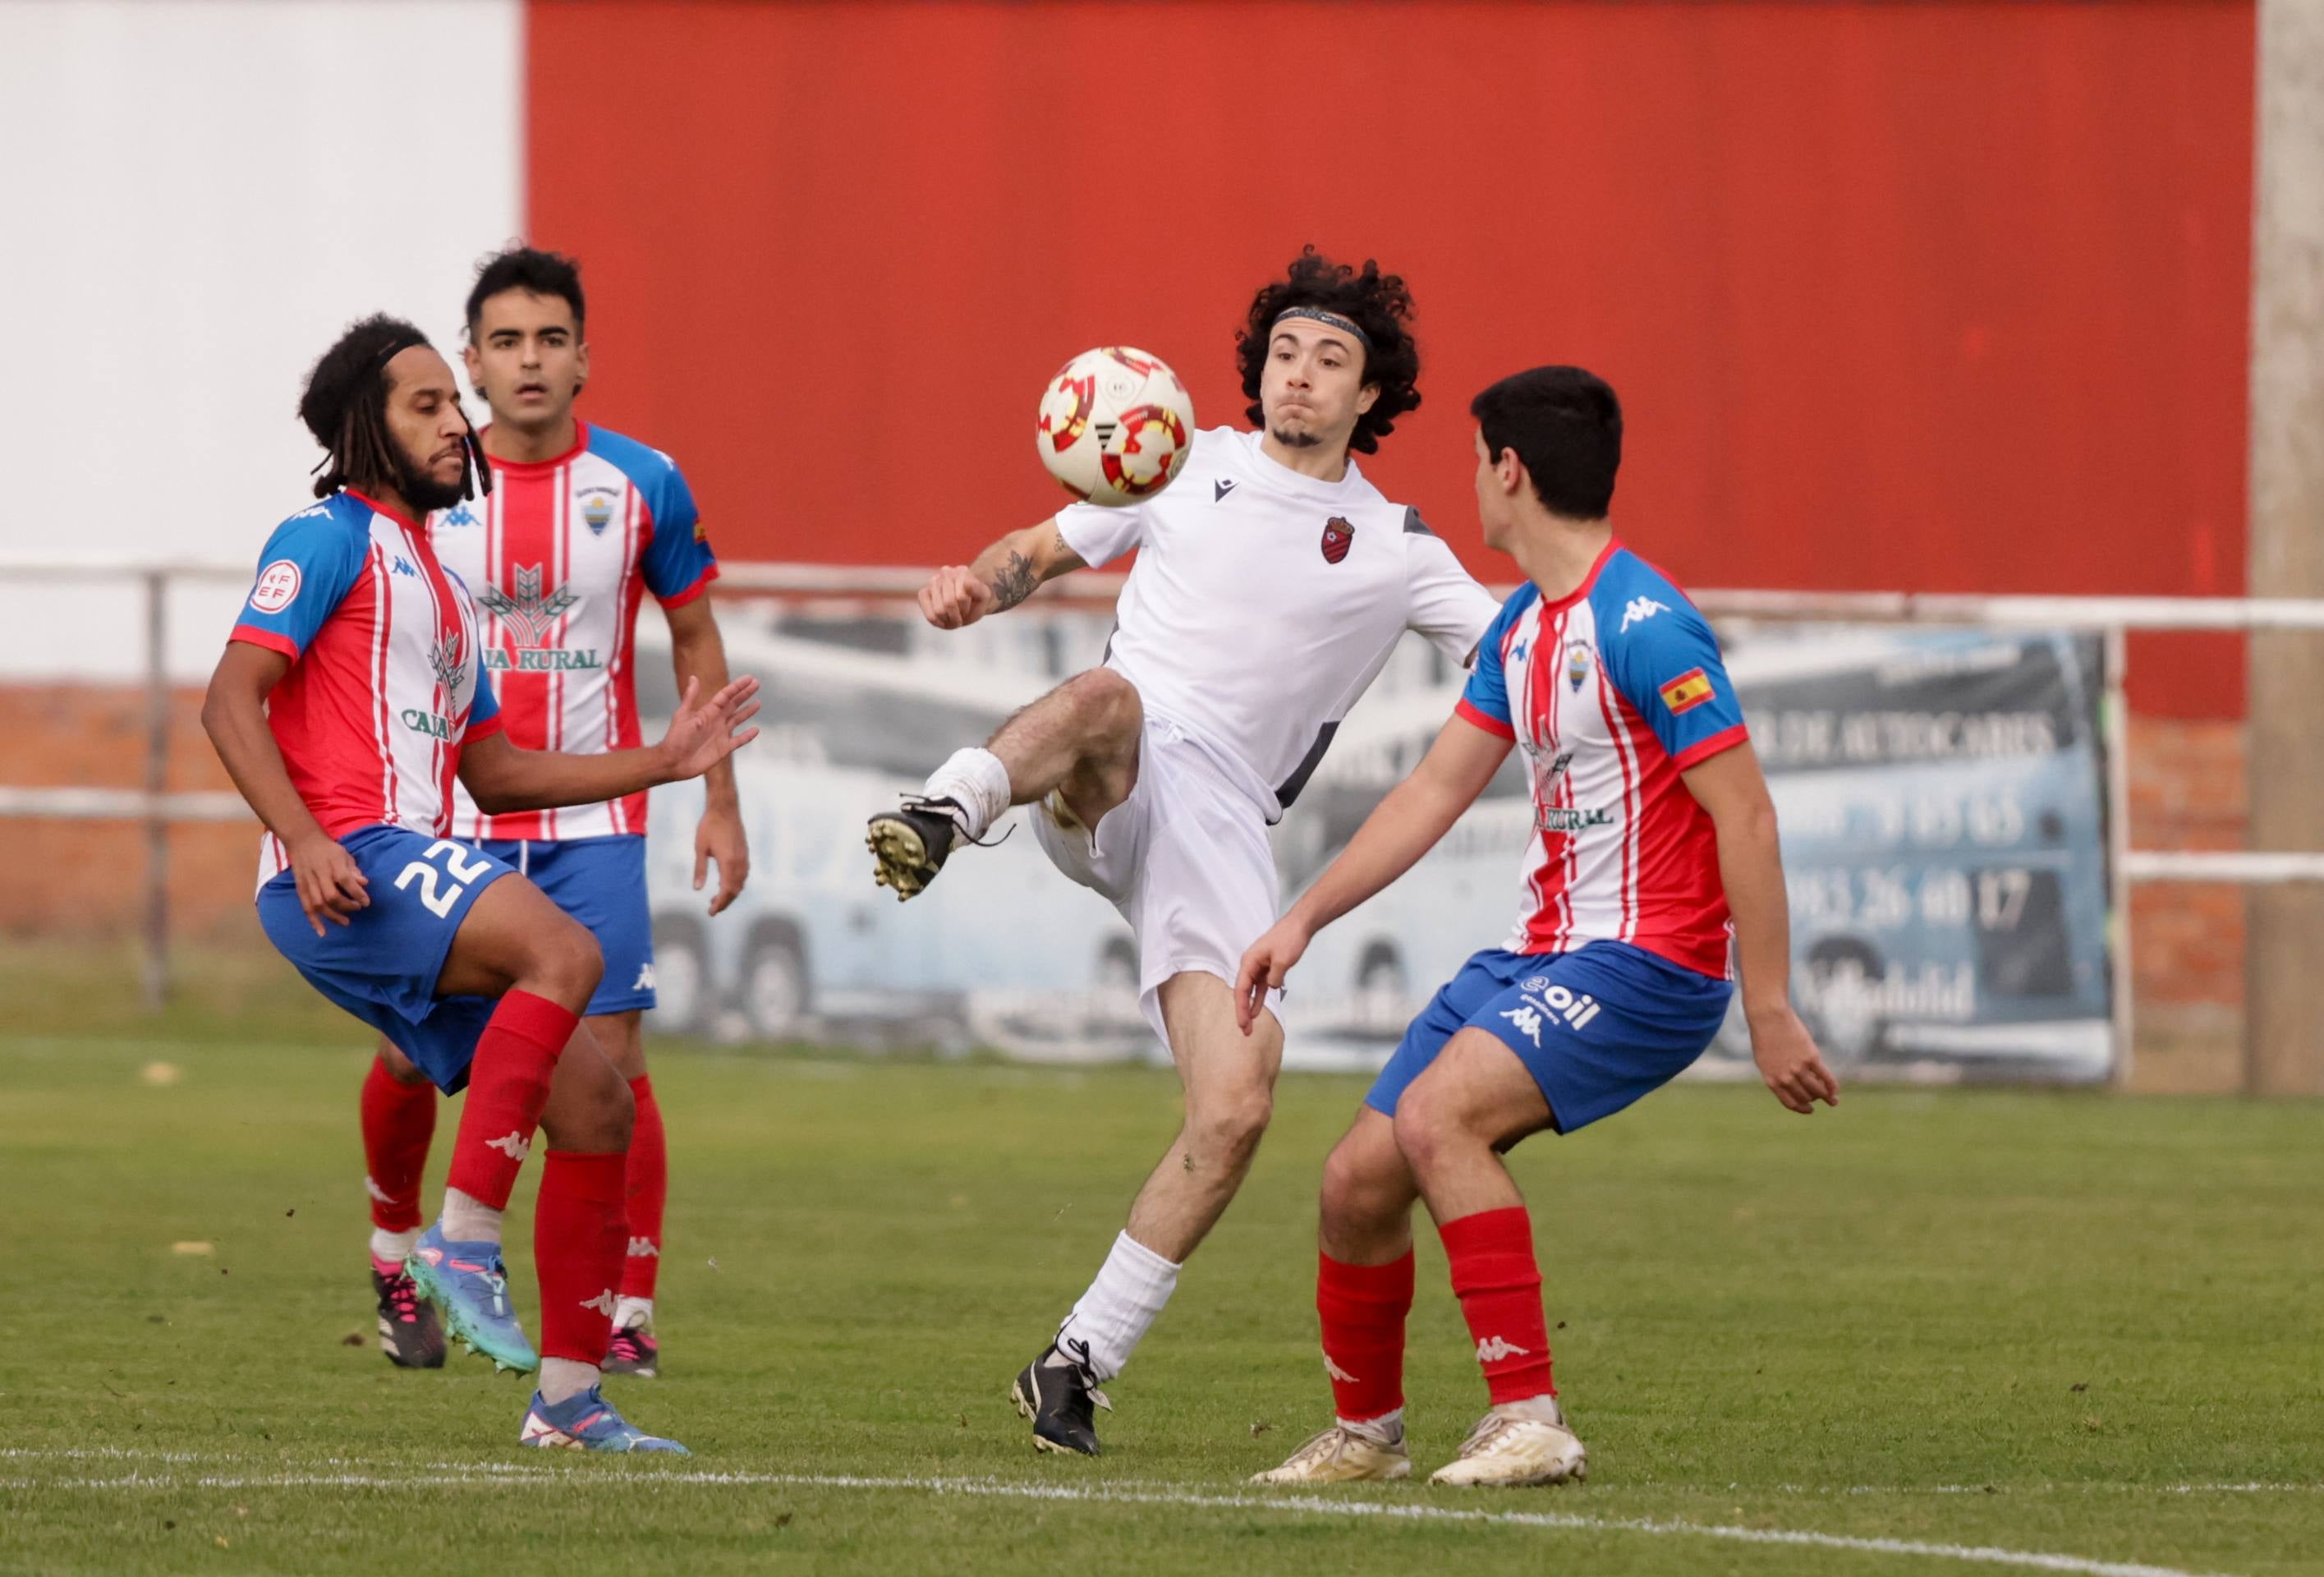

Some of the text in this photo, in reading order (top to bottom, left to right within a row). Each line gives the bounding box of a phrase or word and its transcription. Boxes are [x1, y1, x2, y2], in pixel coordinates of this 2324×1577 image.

[517, 648, 602, 670] RURAL
[394, 840, 492, 918] 22
[1977, 867, 2032, 933] 17
